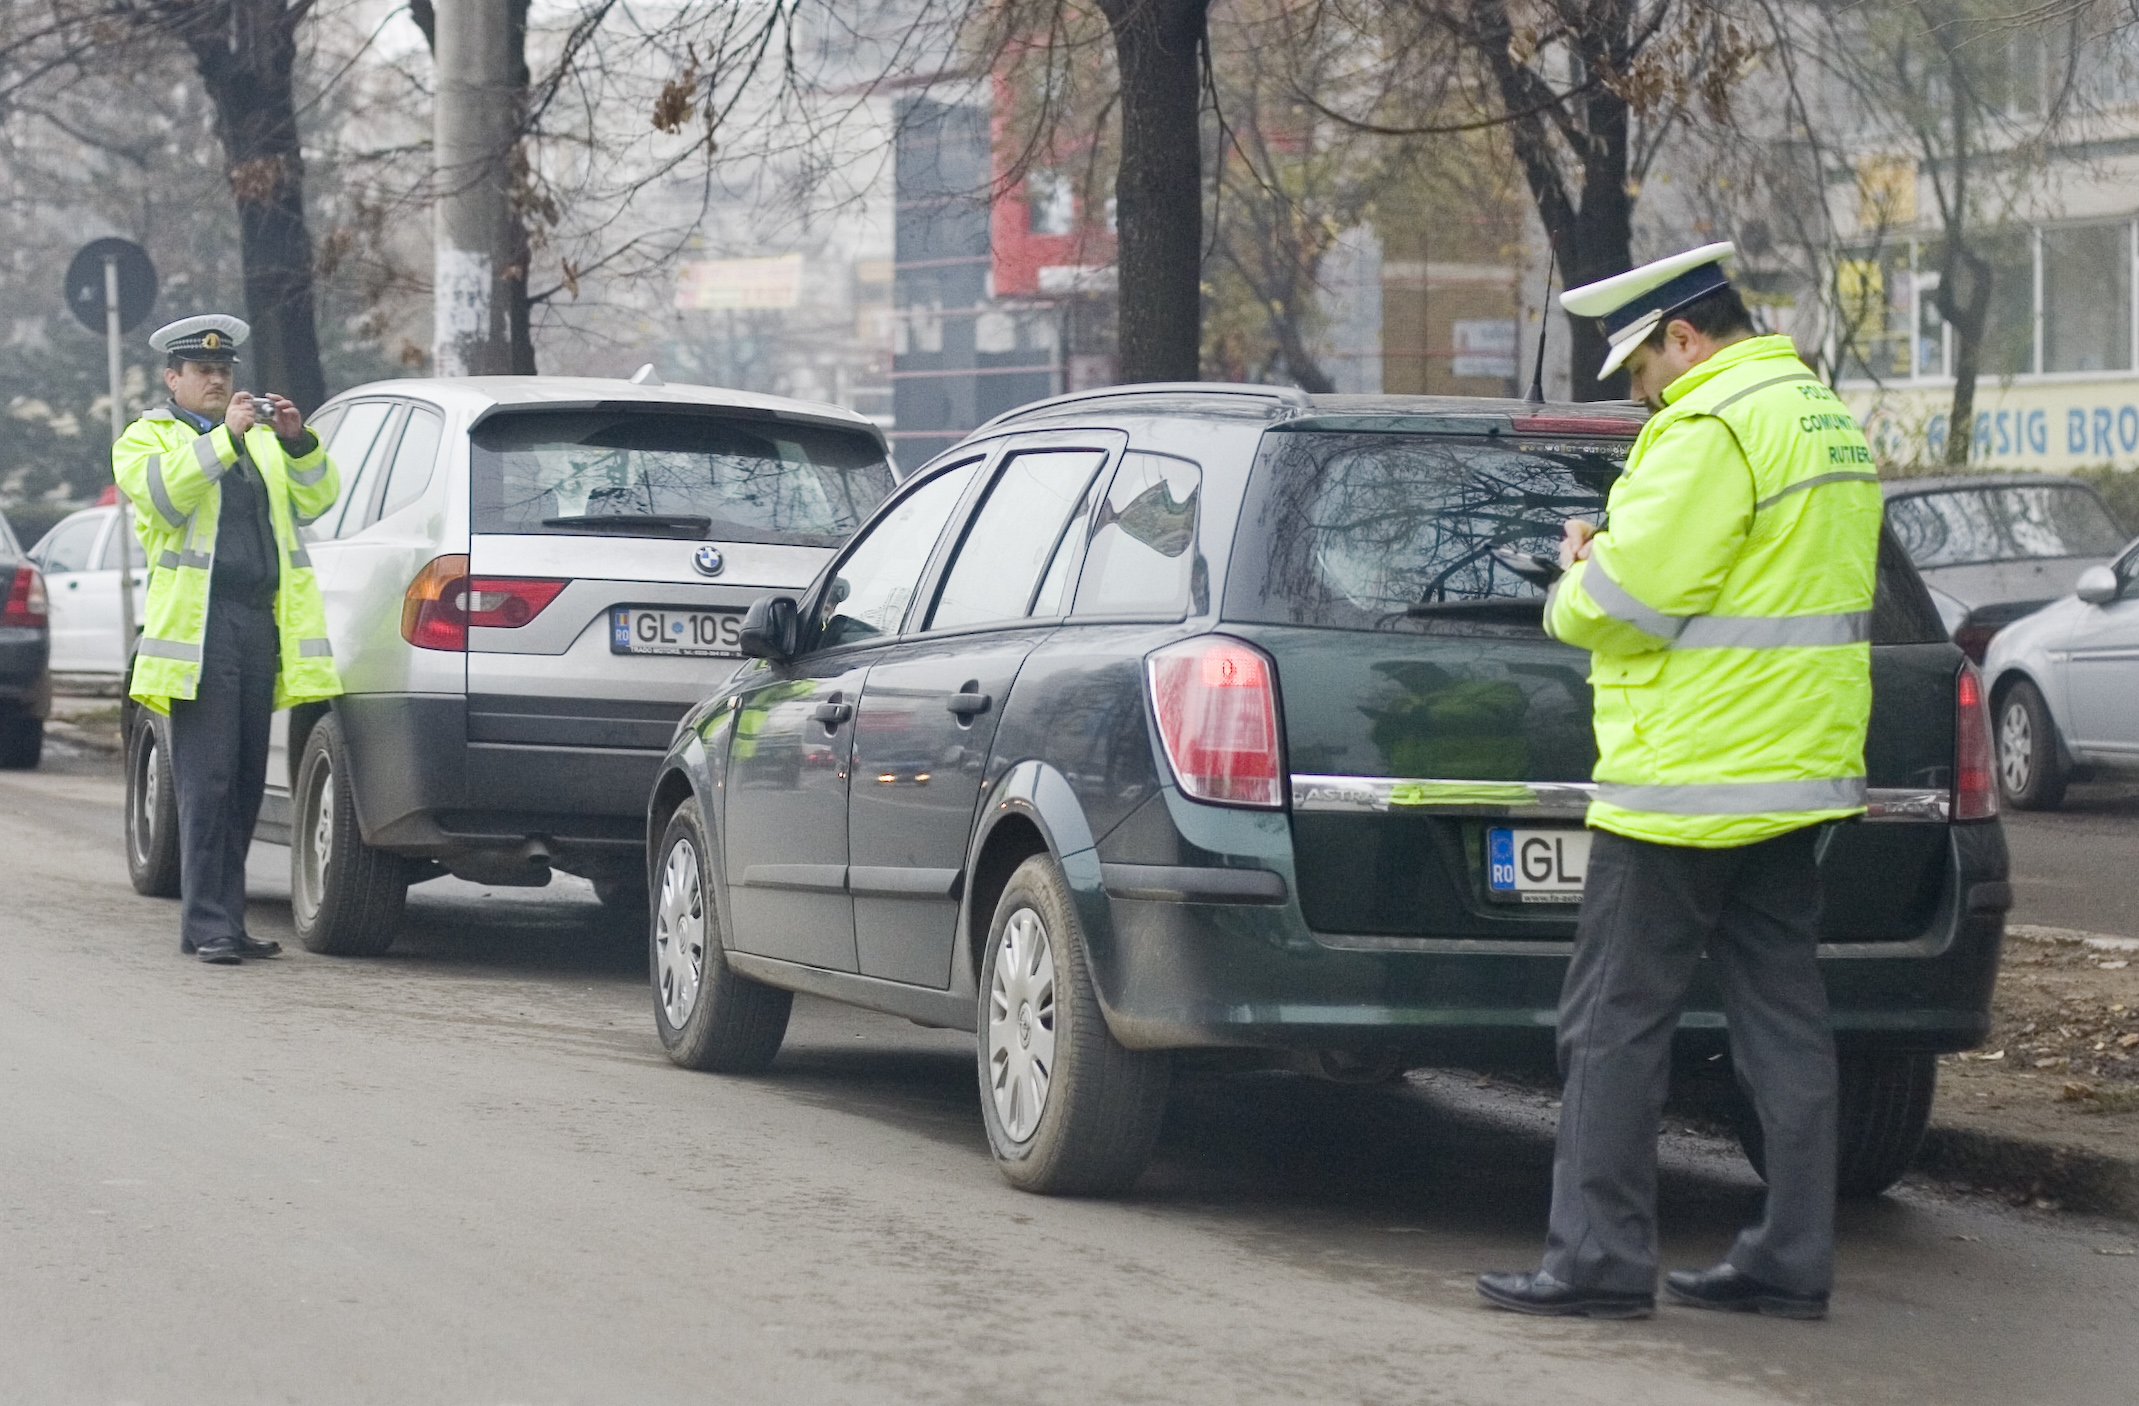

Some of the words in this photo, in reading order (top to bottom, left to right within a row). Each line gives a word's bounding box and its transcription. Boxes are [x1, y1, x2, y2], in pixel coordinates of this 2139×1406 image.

[2068, 405, 2138, 457] BRO
[615, 629, 629, 642] RO
[637, 613, 677, 644] GL
[1305, 788, 1379, 801] ASTRA
[1521, 837, 1582, 883] GL
[1493, 864, 1513, 883] RO
